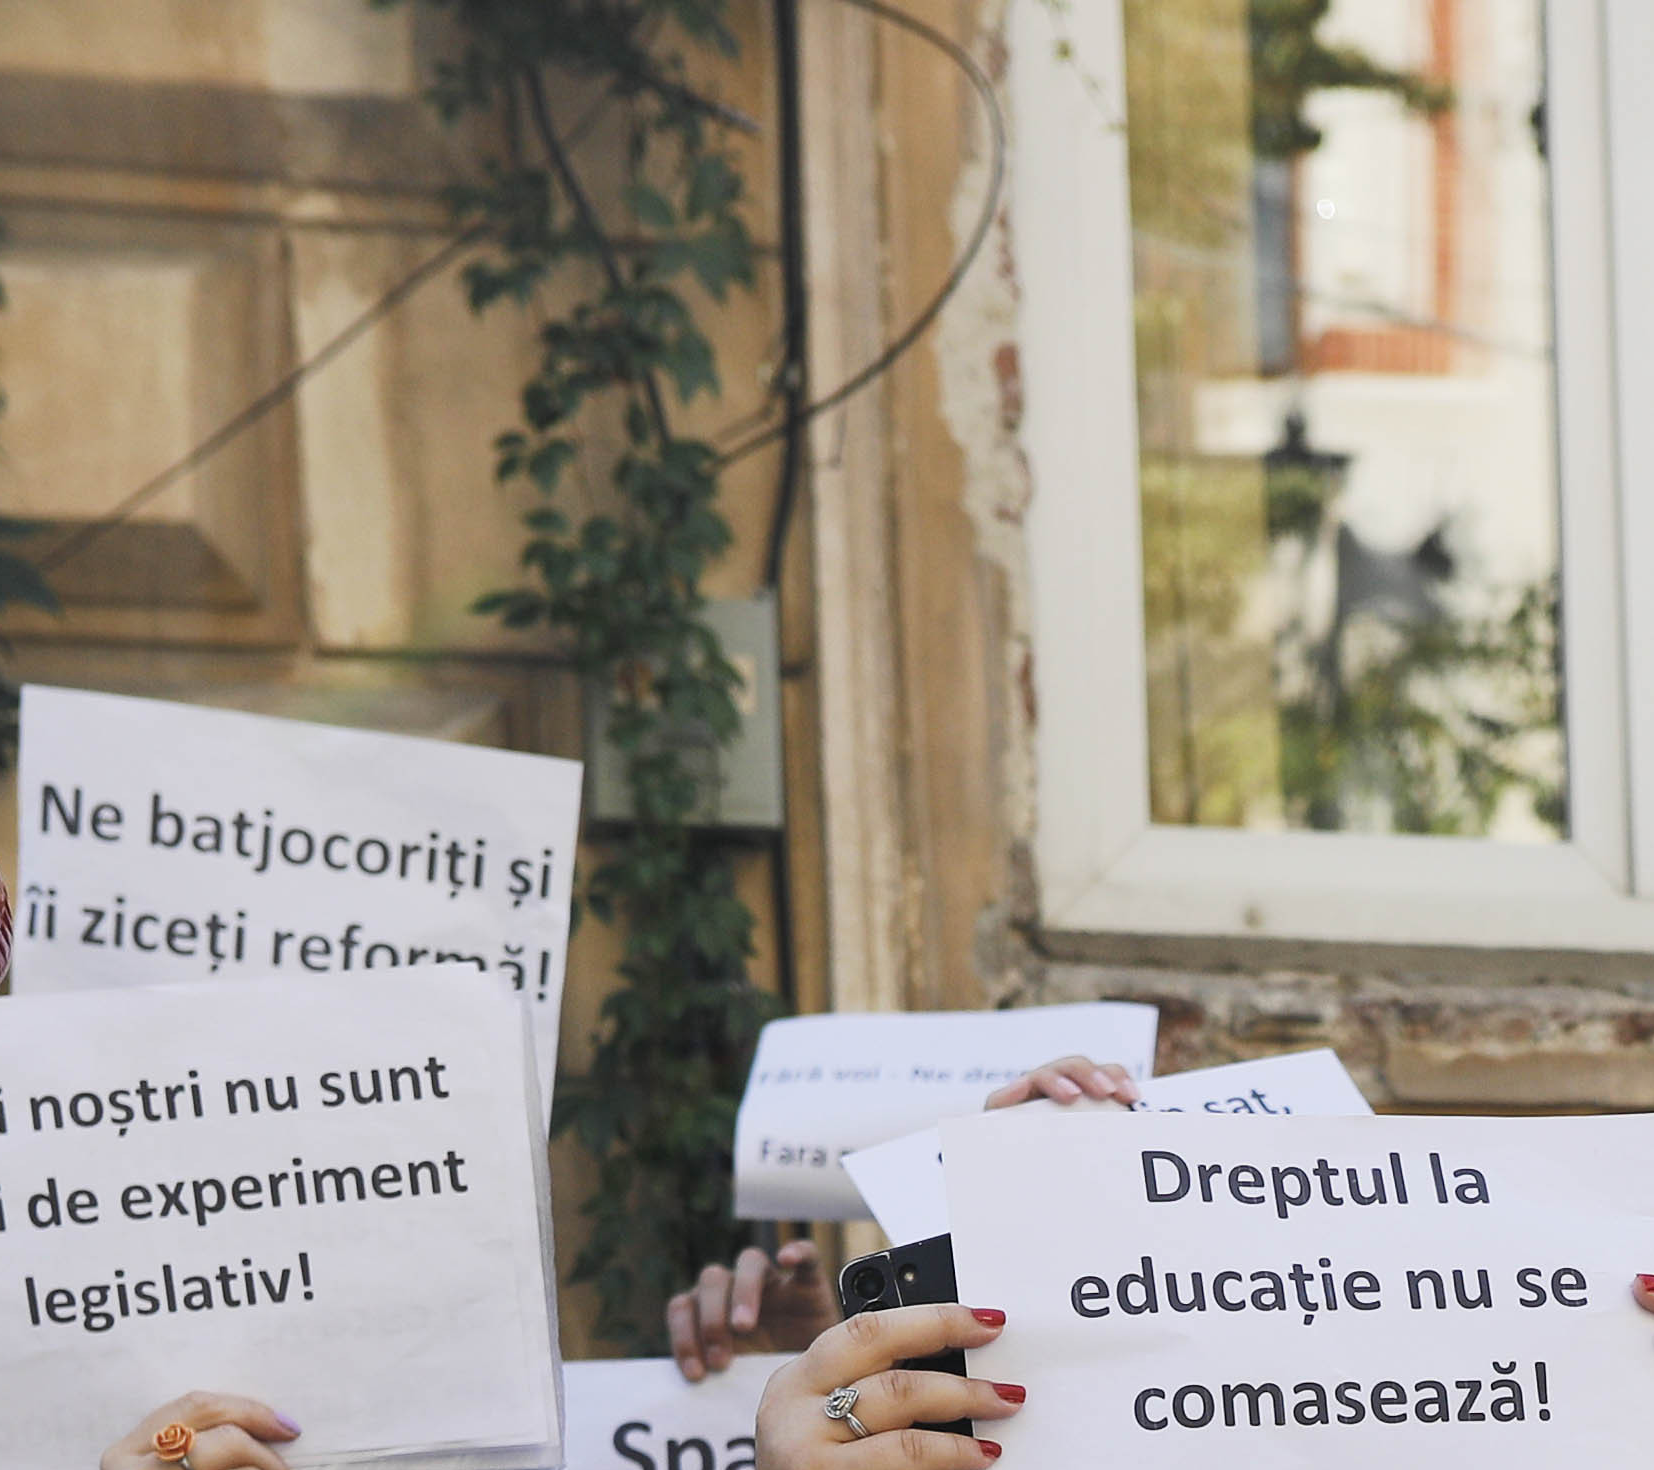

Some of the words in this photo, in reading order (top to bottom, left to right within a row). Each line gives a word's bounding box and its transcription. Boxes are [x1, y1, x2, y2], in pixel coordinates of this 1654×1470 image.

[41, 784, 123, 842] Ne
[149, 793, 486, 899] batjocoriți
[508, 848, 553, 908] și
[27, 885, 57, 941] îi
[80, 896, 246, 973] ziceți
[29, 1069, 204, 1137] noștri
[225, 1075, 299, 1115] nu
[319, 1056, 450, 1108] sunt
[27, 1177, 99, 1229] de
[120, 1150, 469, 1227] experiment
[1141, 1150, 1409, 1220] Dreptul
[1428, 1152, 1490, 1205] la
[24, 1252, 314, 1333] legislativ!
[1070, 1255, 1382, 1326] educație
[1405, 1269, 1493, 1310] nu
[1516, 1267, 1588, 1308] se
[1133, 1360, 1551, 1431] comasează!
